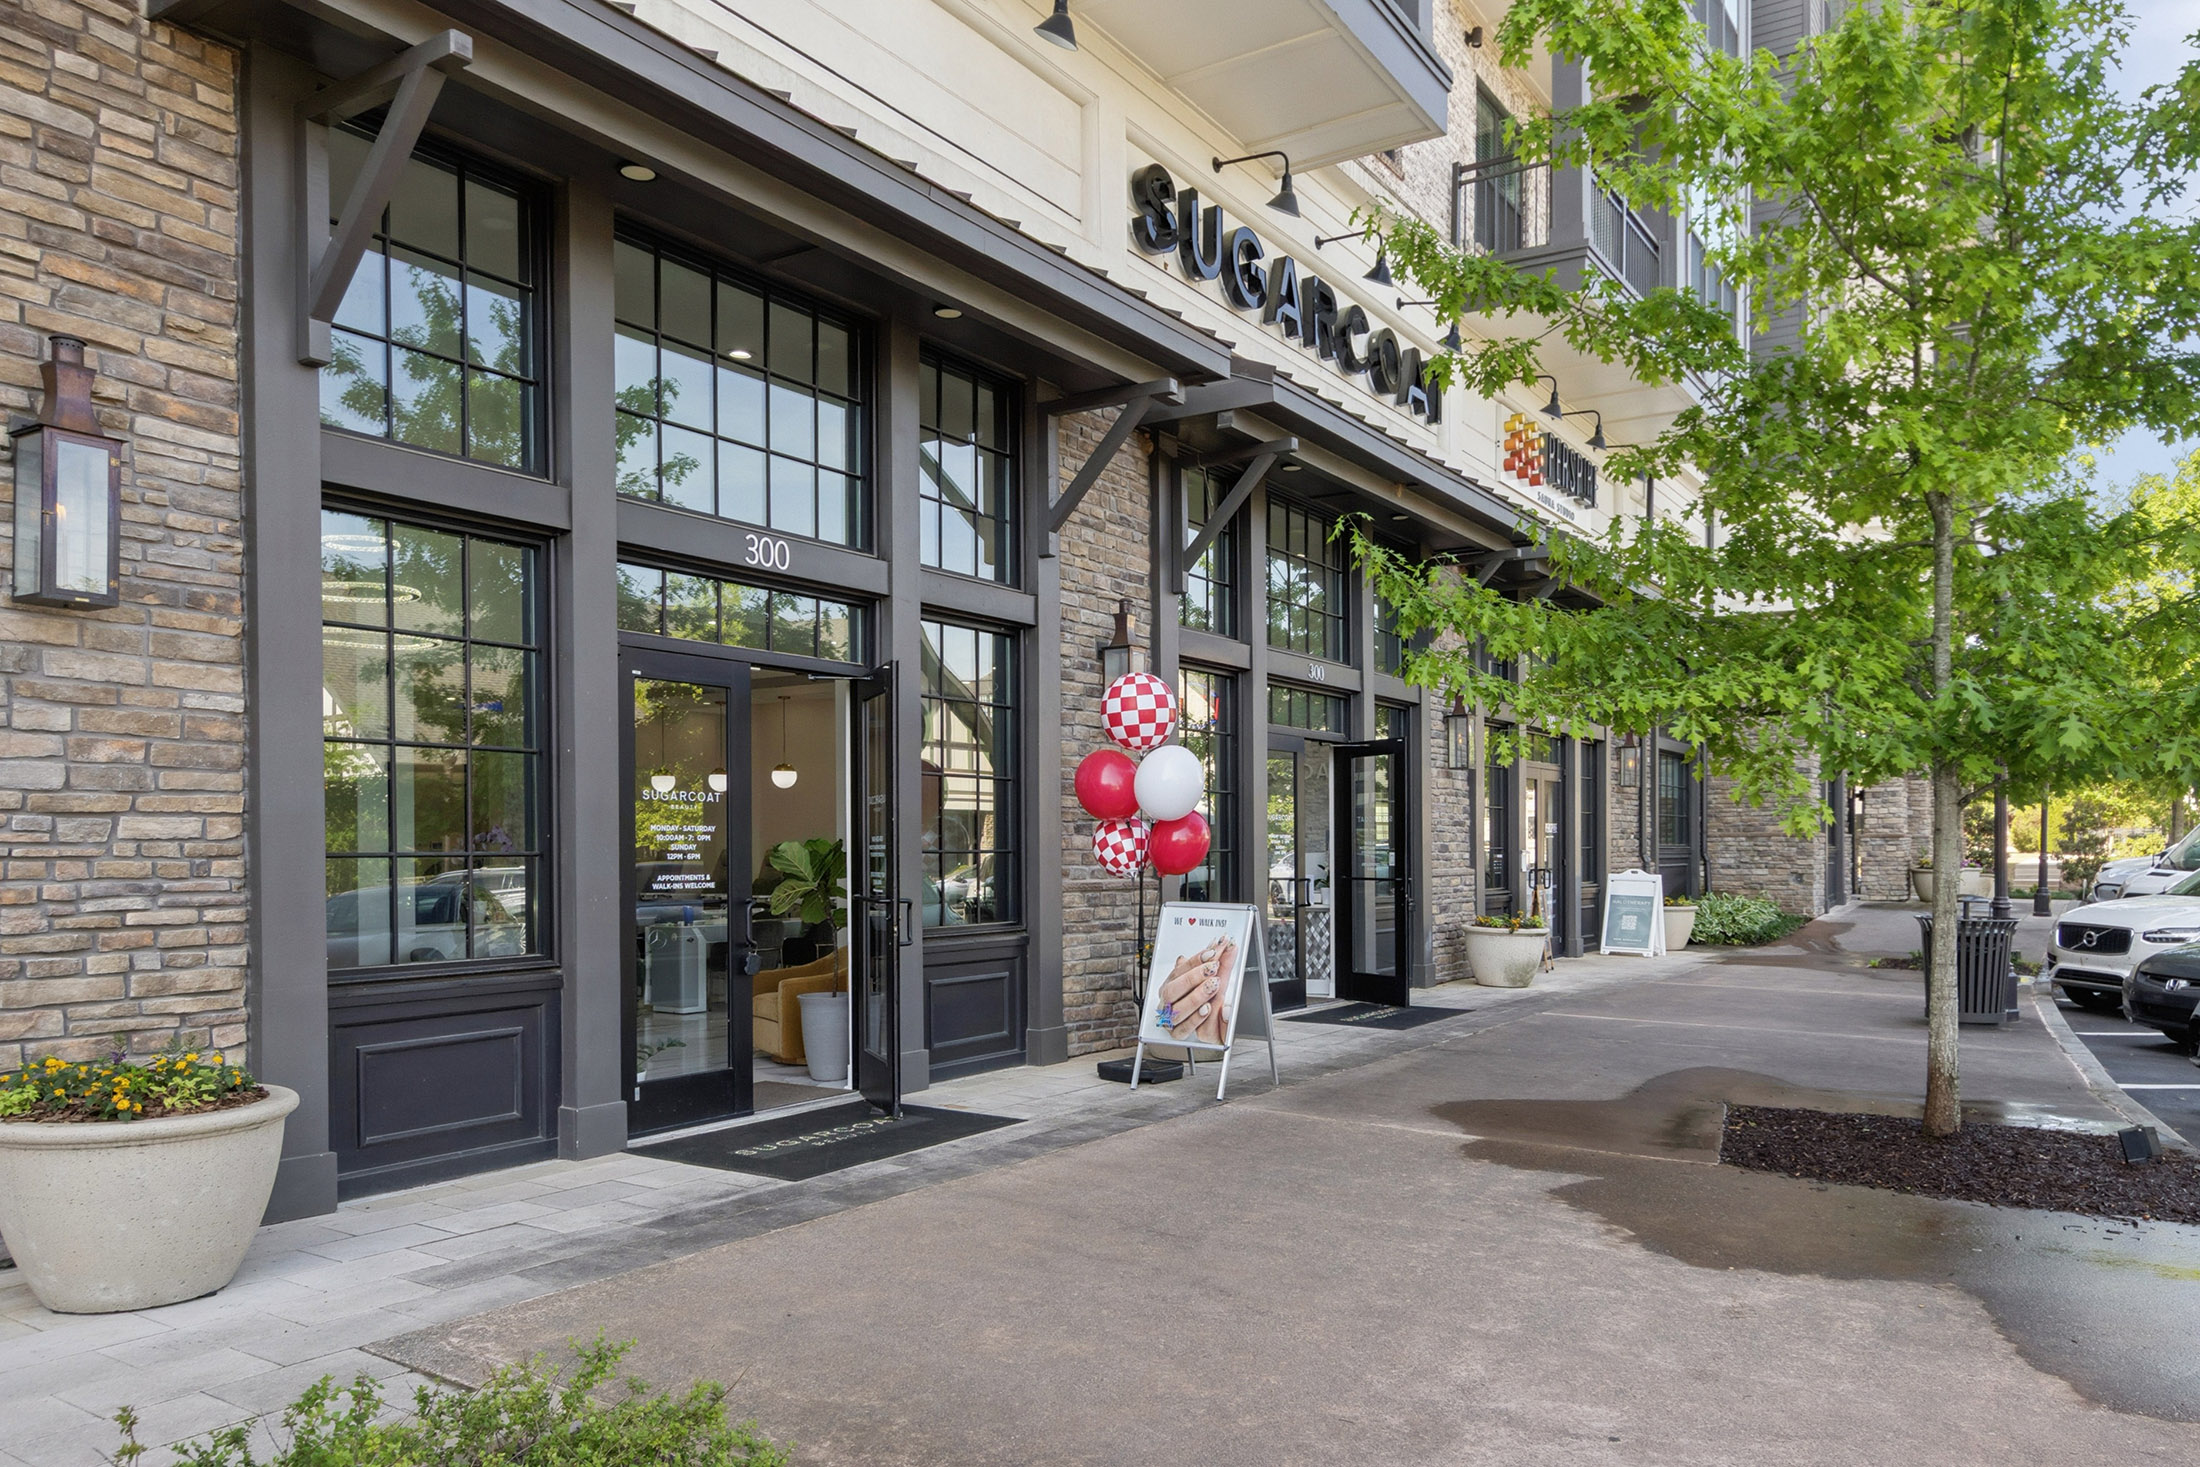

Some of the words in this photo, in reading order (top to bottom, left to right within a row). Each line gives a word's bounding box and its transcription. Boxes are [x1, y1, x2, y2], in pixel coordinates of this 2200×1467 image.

[1557, 503, 1575, 521] STUDIO
[745, 534, 790, 570] 300
[1308, 663, 1325, 681] 300
[642, 789, 721, 803] SUGARCOAT
[650, 824, 679, 832] MONDAY
[670, 843, 697, 851] SUNDAY
[652, 882, 683, 890] WALK-INS
[735, 1115, 894, 1156] SUGARCOA
